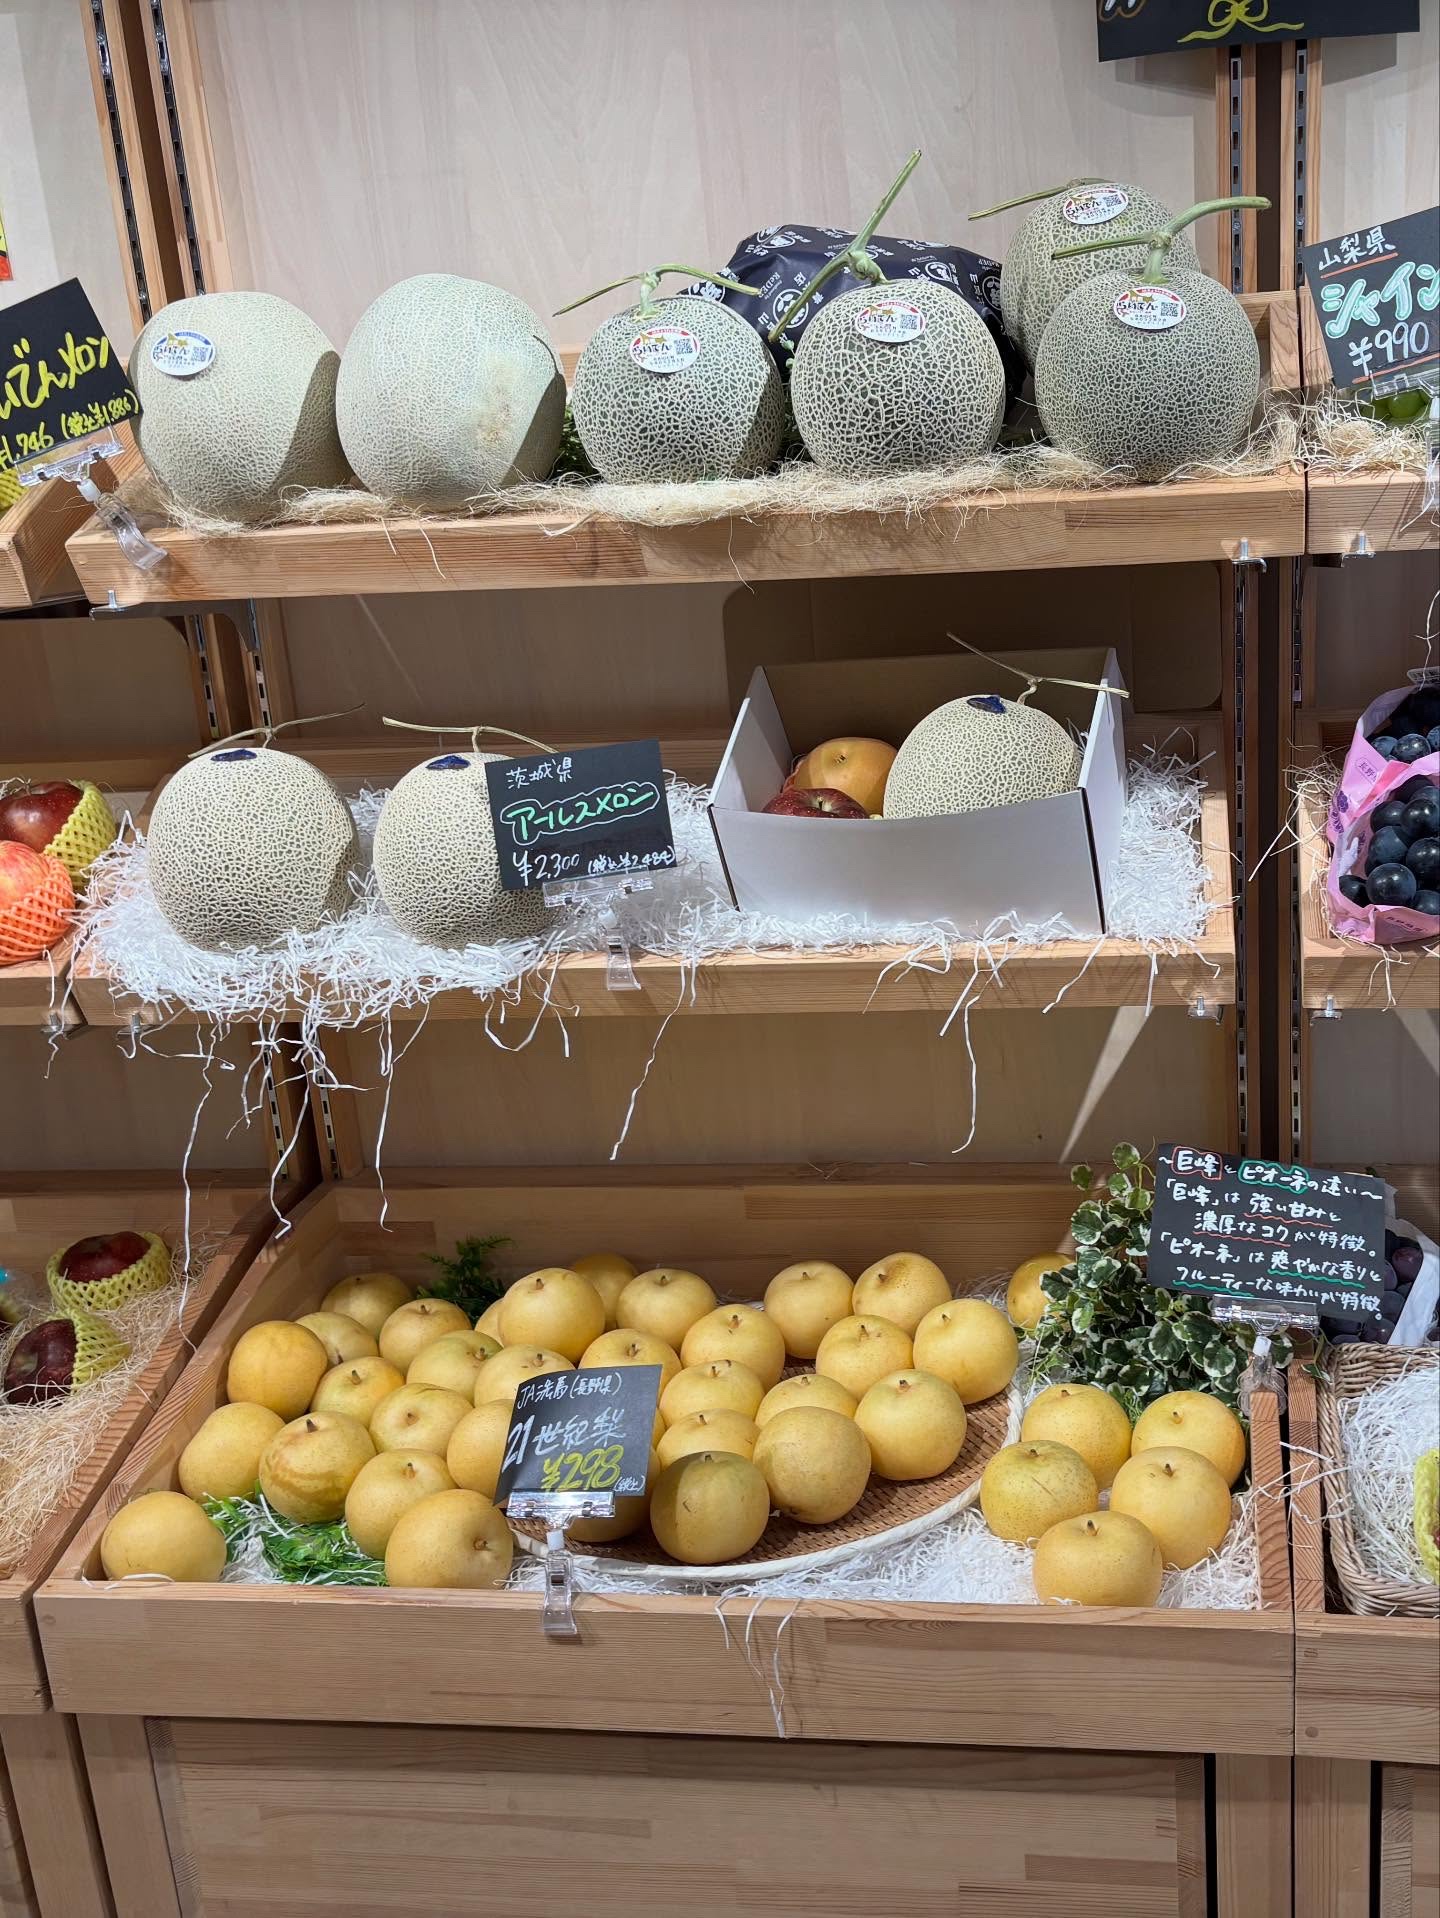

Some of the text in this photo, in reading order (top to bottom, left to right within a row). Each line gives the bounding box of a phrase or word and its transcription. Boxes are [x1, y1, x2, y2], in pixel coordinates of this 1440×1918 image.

[1319, 226, 1396, 270] 山梨県
[1349, 322, 1429, 376] ¥990
[506, 757, 572, 789] 茨城県
[507, 788, 653, 840] アールスメロン
[502, 1407, 627, 1473] 21世紀梨
[541, 1444, 624, 1493] ¥298
